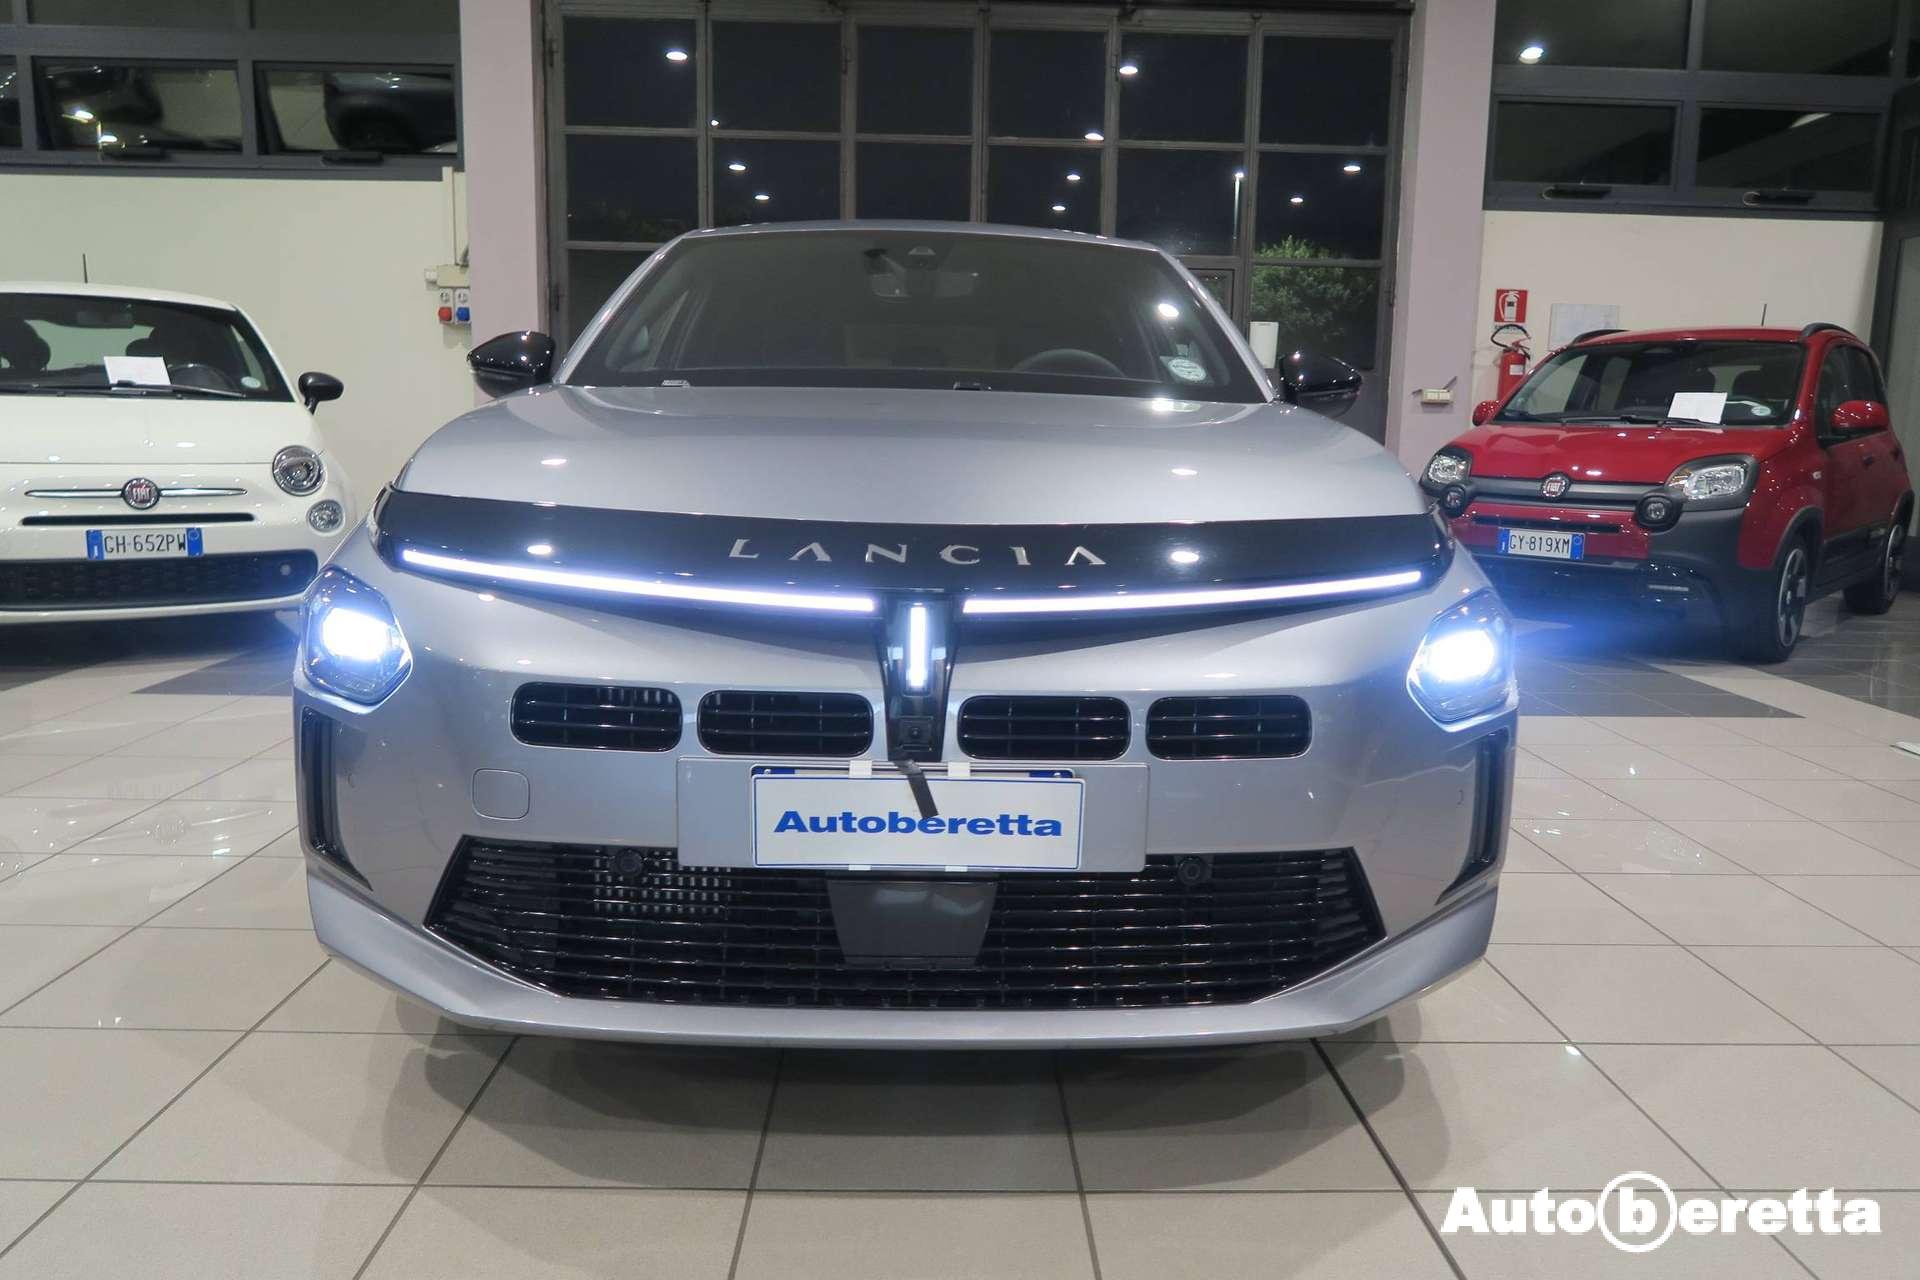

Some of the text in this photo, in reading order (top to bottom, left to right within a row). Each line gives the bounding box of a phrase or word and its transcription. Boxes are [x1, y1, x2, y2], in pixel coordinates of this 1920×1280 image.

[133, 486, 151, 500] FIAT
[728, 538, 1107, 566] LANCIA
[773, 810, 1063, 837] Autoberetta
